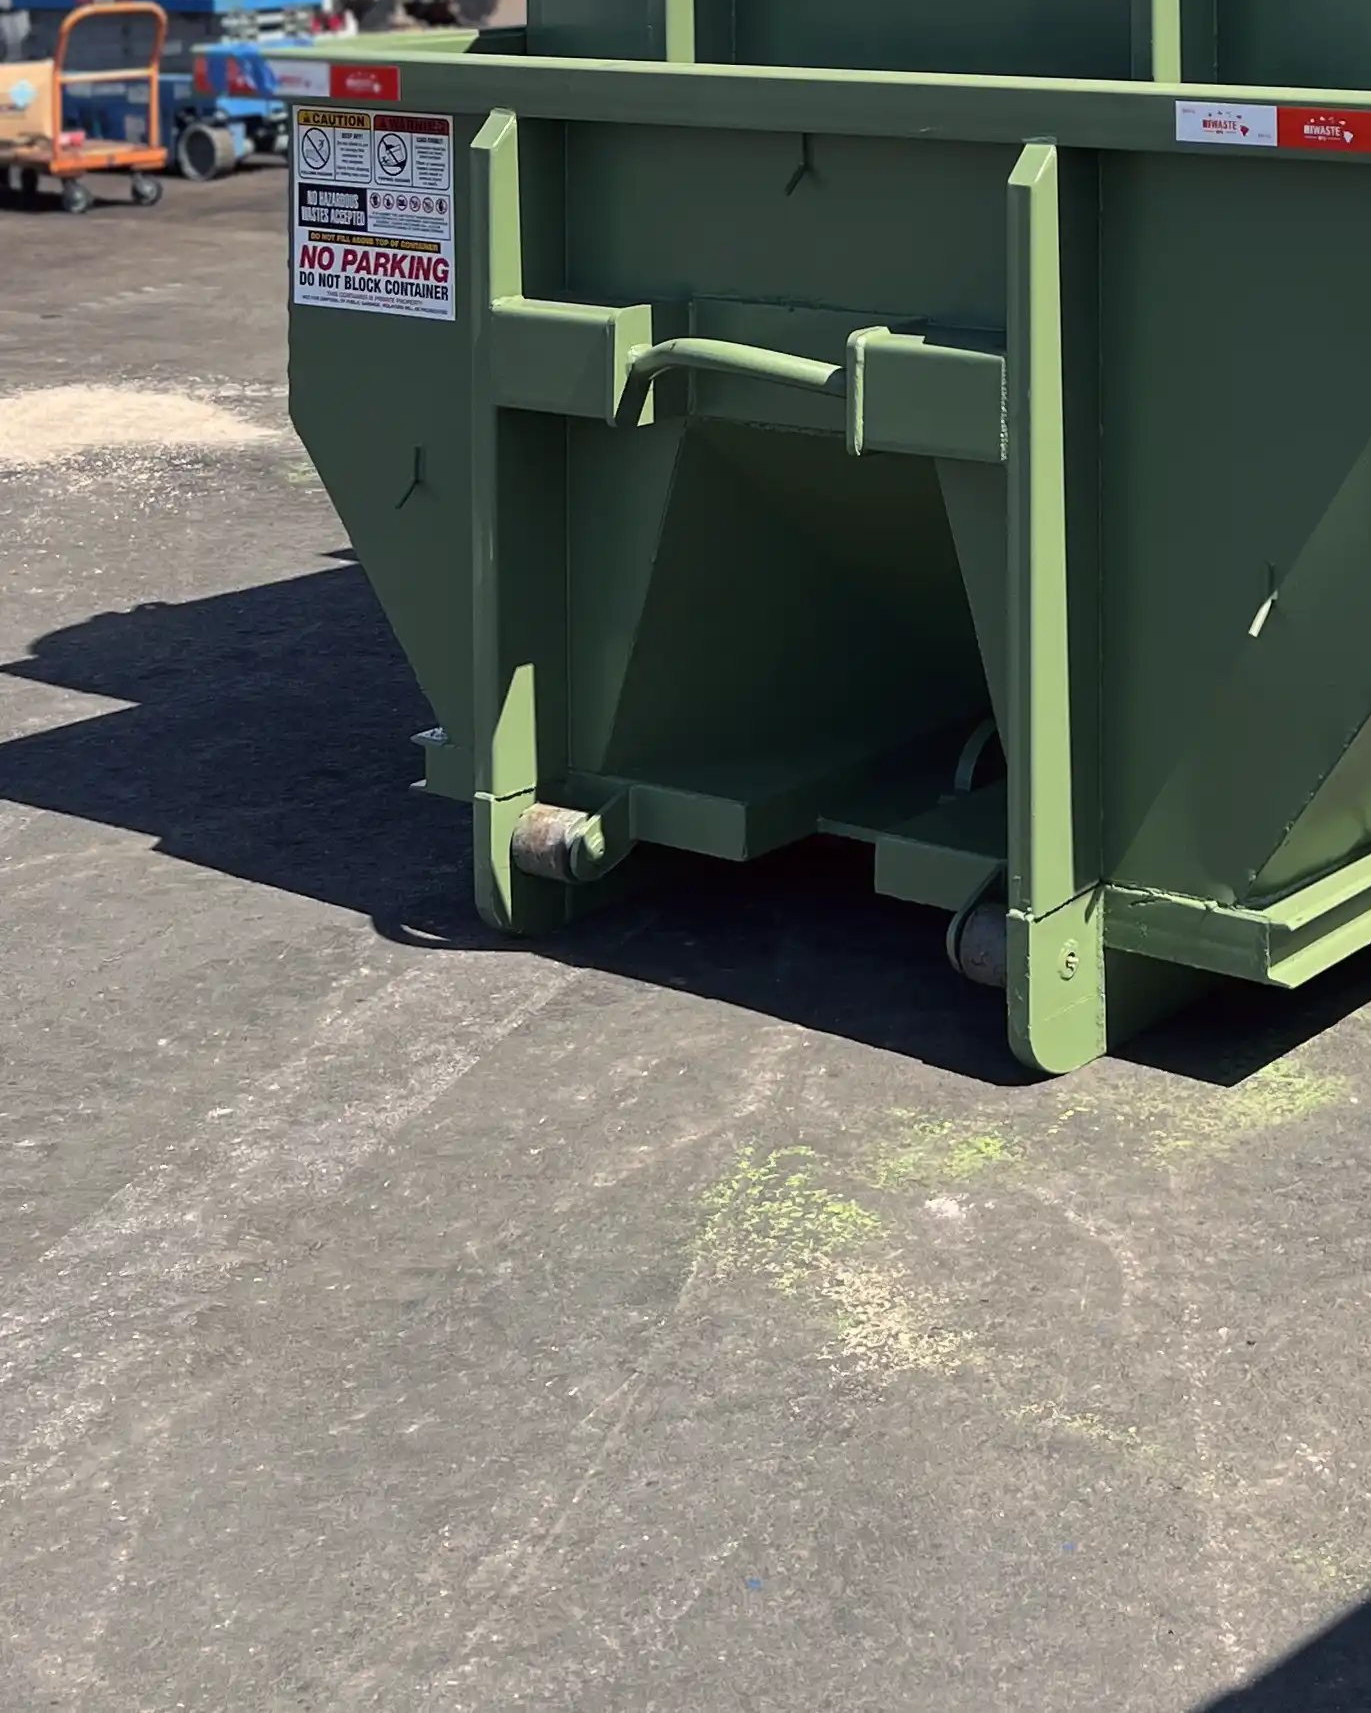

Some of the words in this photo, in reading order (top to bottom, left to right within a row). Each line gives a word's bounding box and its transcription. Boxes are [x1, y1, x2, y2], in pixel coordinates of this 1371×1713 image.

[312, 112, 364, 127] CAUTION
[1303, 124, 1341, 136] HIWASTE
[306, 189, 317, 204] NO
[319, 190, 358, 209] HAZARDOUS
[301, 206, 328, 222] WASTES
[330, 208, 365, 226] ACCEPTED
[299, 243, 334, 271] NO
[340, 247, 449, 283] PARKING
[299, 270, 314, 286] DO
[318, 272, 340, 289] NOT
[344, 275, 381, 293] BLOCK
[385, 279, 448, 300] CONTAINER
